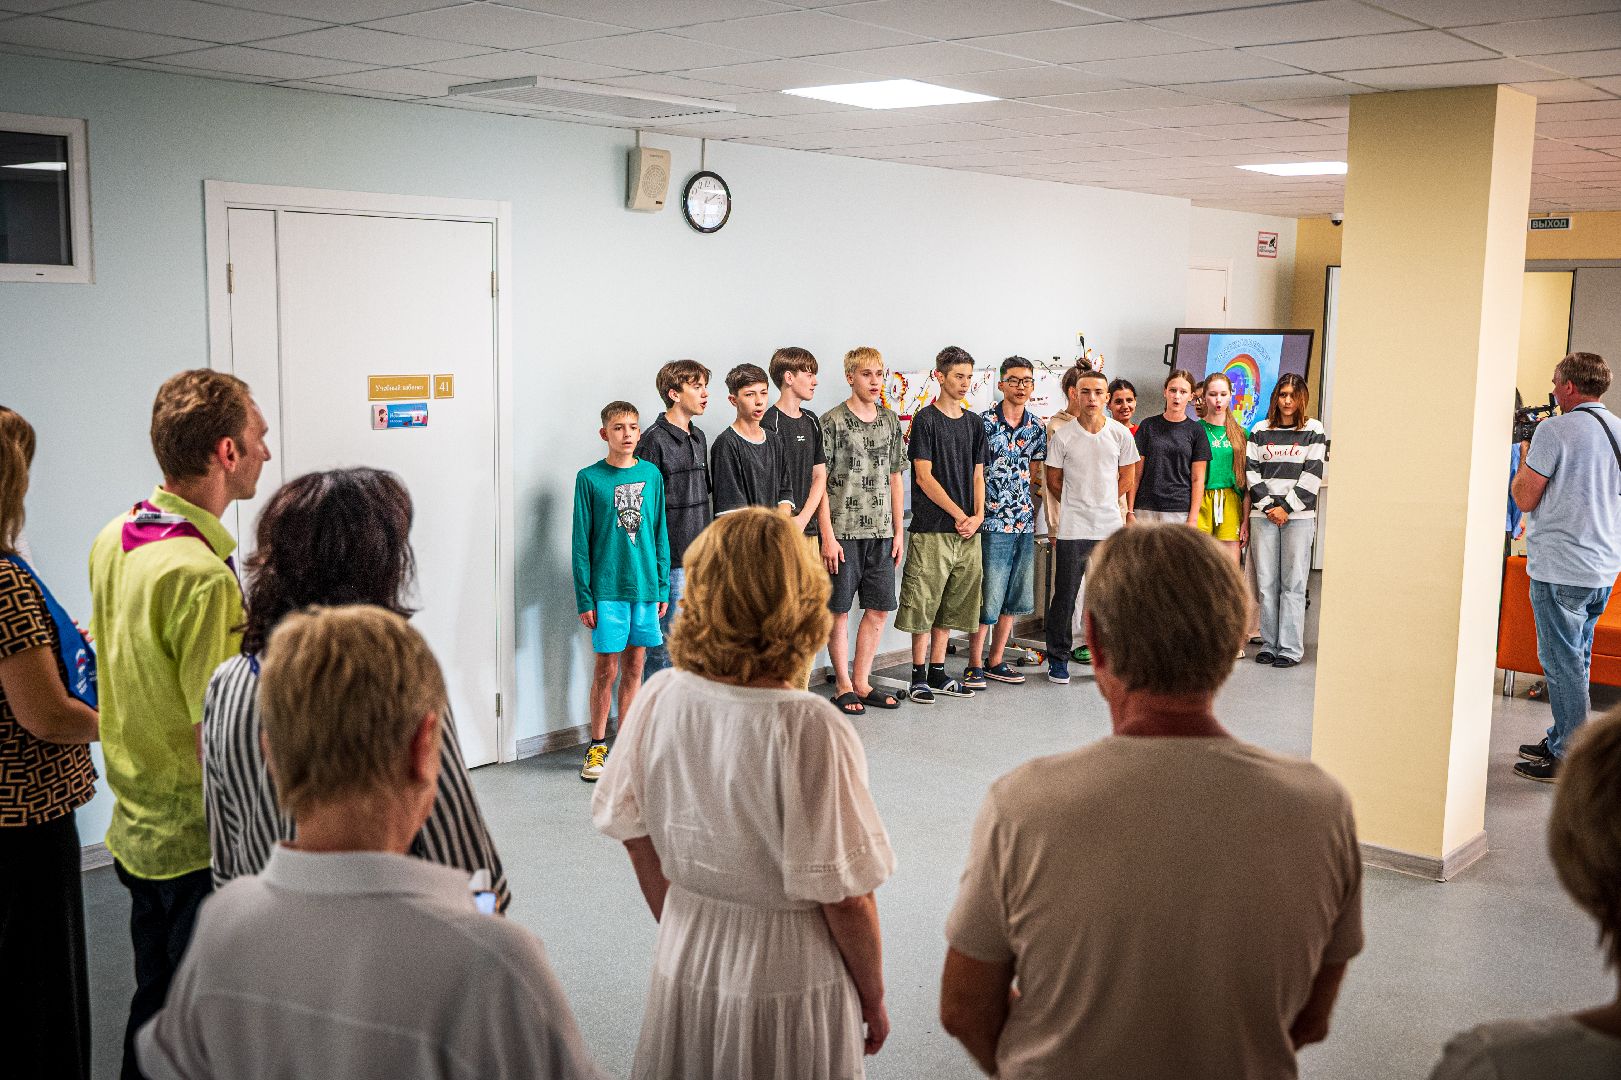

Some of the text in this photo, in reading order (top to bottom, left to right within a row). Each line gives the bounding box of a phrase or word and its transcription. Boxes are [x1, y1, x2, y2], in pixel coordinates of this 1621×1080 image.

[1532, 219, 1567, 228] ВЫХОД
[439, 381, 449, 392] 41
[1262, 442, 1302, 460] Smile
